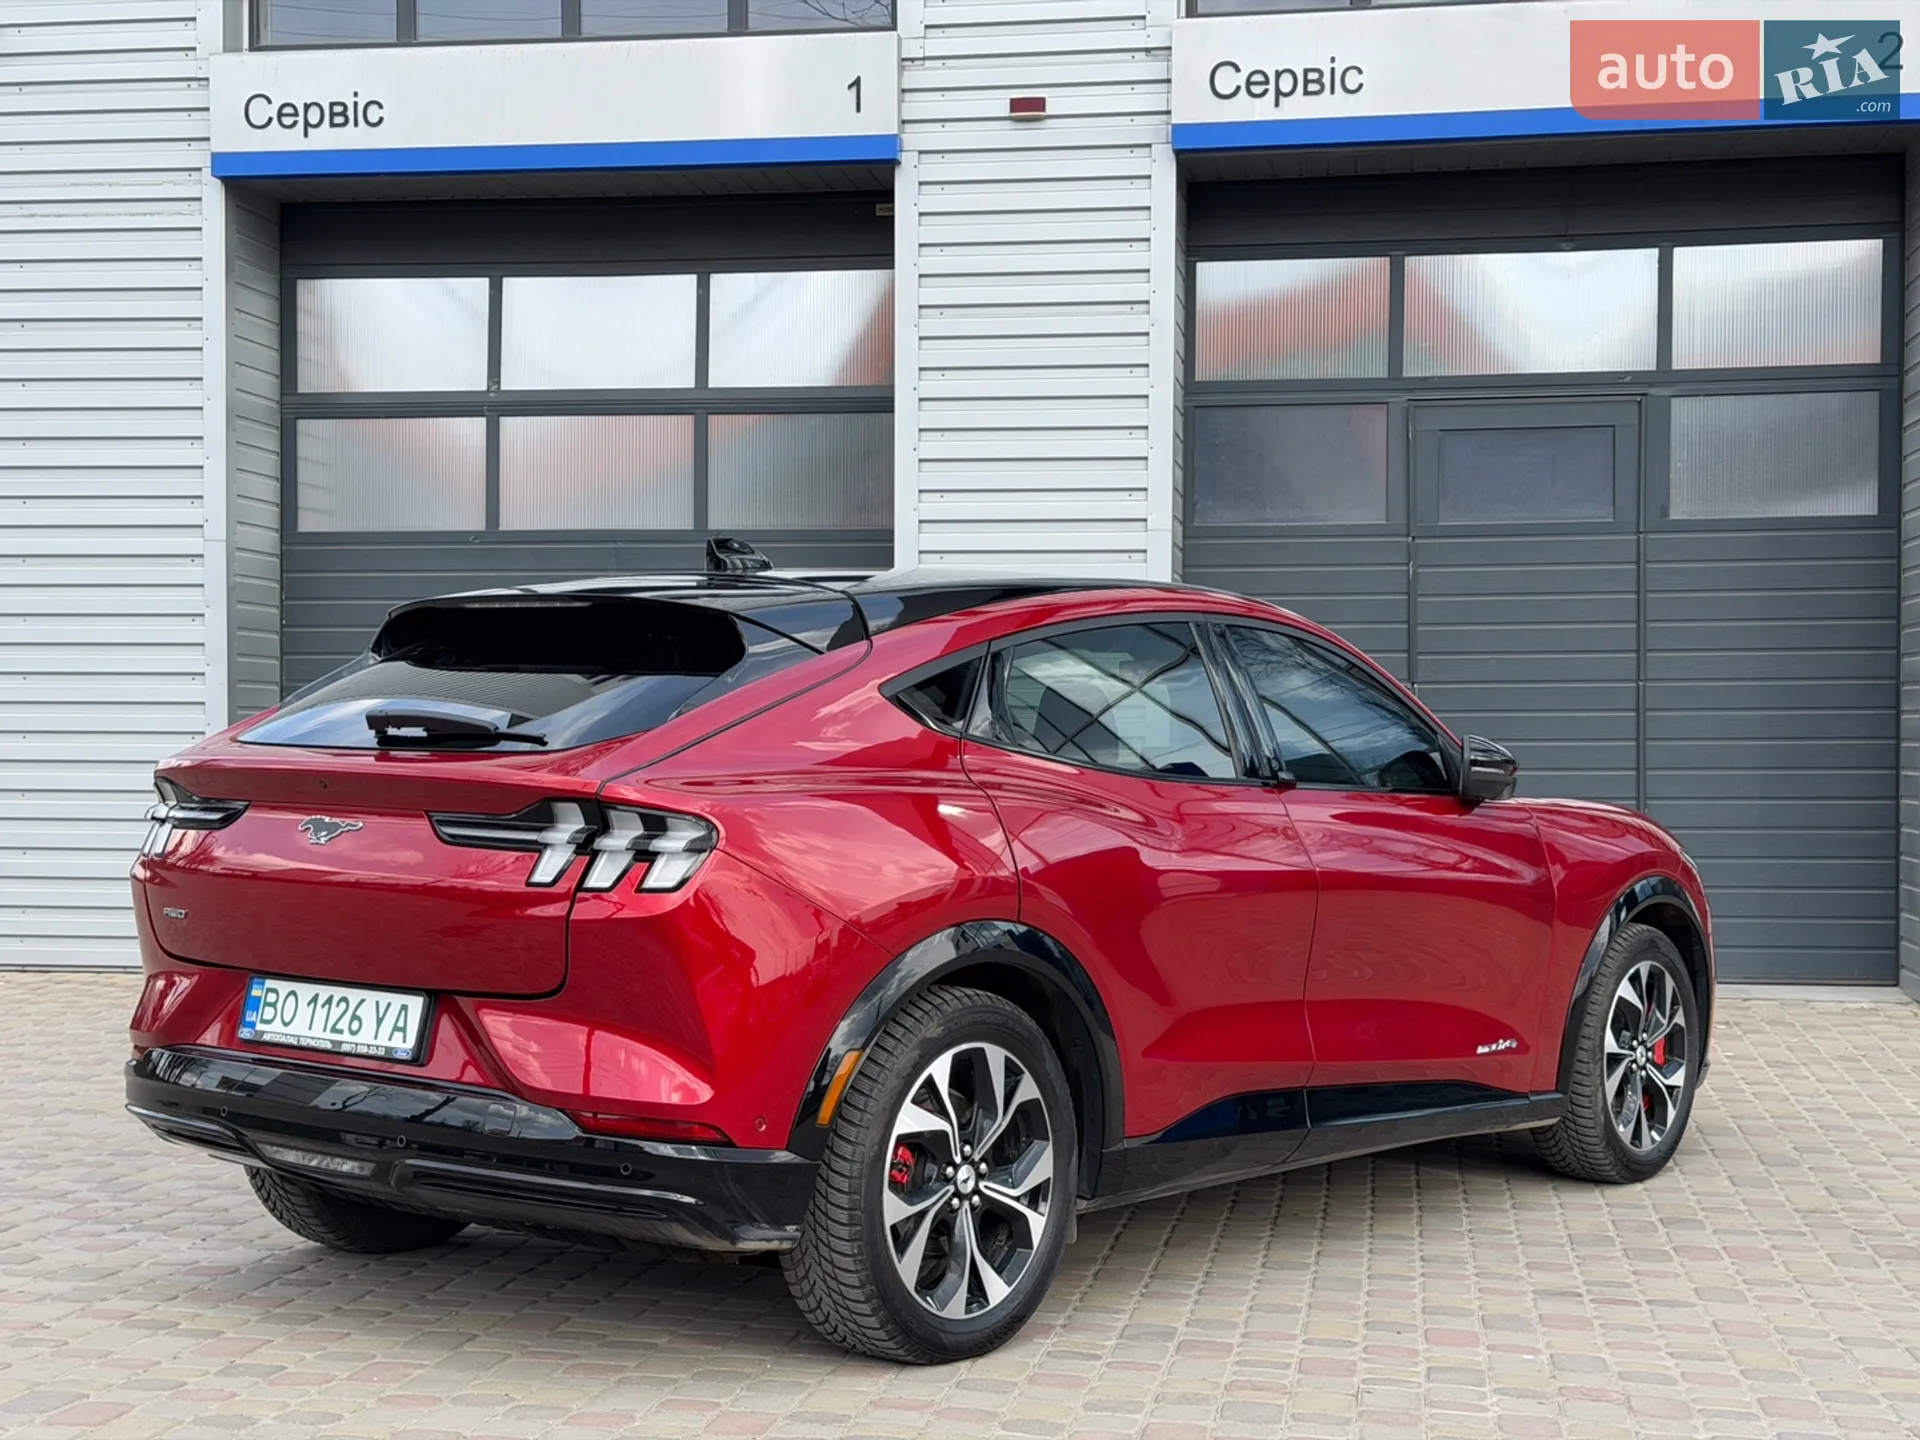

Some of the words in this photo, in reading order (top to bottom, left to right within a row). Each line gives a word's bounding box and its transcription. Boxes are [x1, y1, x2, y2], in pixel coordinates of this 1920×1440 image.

[846, 76, 862, 114] 1
[1208, 56, 1365, 108] Сервіс
[243, 91, 385, 138] Сервіс
[246, 1010, 257, 1023] UA
[259, 987, 299, 1028] BO
[306, 992, 367, 1036] 1126
[374, 1000, 410, 1044] YA
